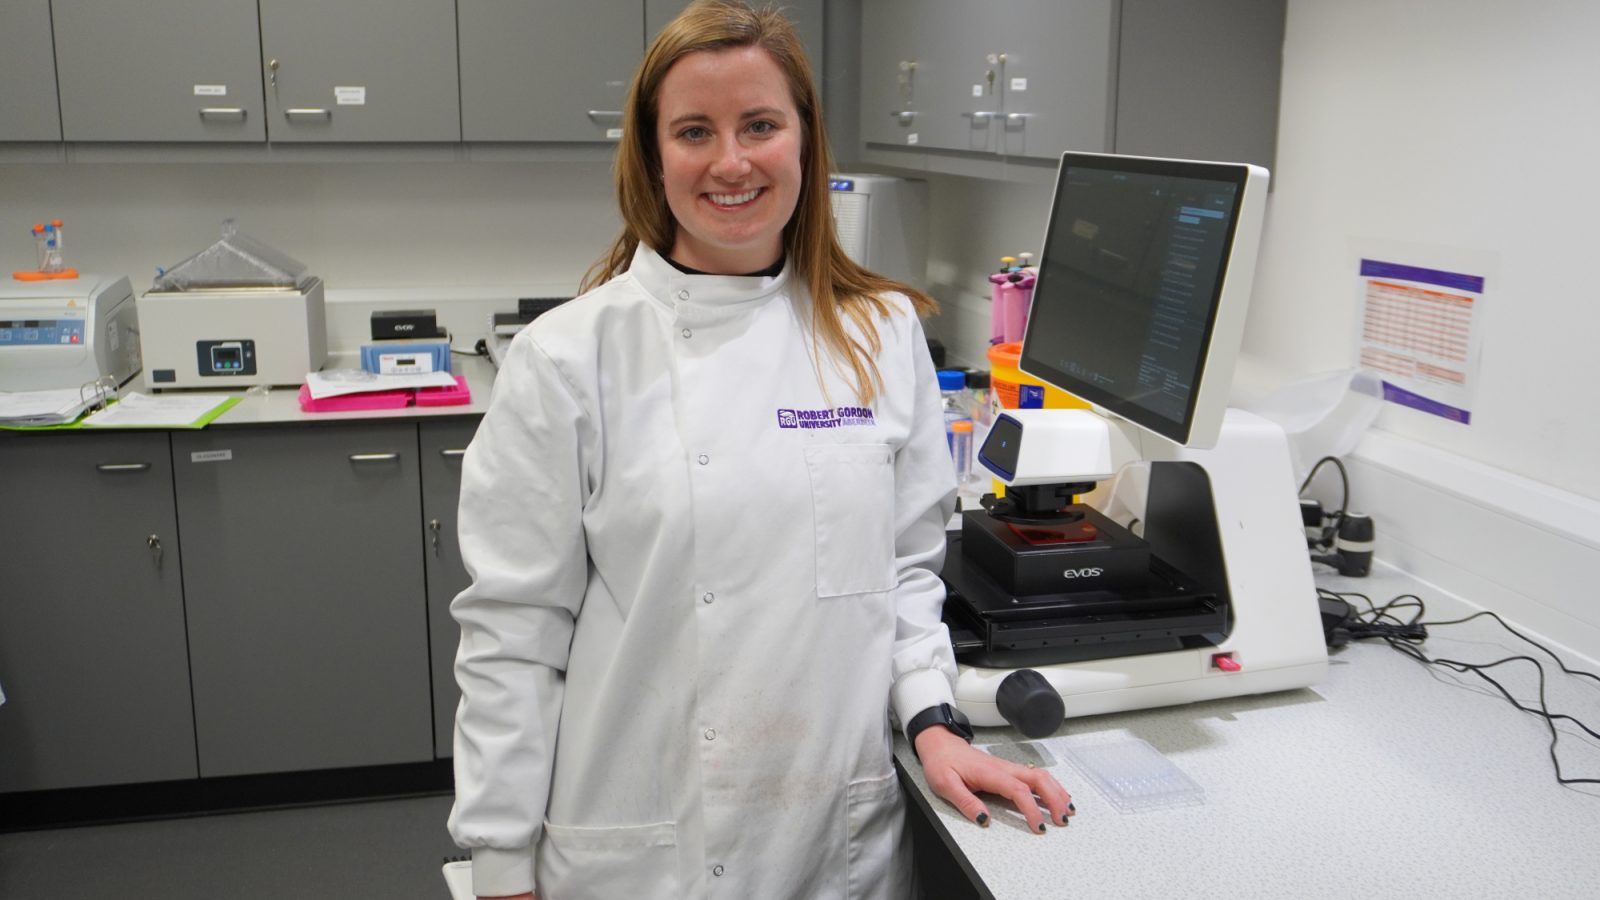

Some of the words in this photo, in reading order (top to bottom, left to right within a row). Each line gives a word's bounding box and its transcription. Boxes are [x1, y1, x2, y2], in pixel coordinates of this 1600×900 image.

[797, 409, 835, 420] ROBERT
[837, 407, 874, 419] GORDON
[779, 416, 797, 427] RGU
[799, 418, 842, 429] UNIVERSITY
